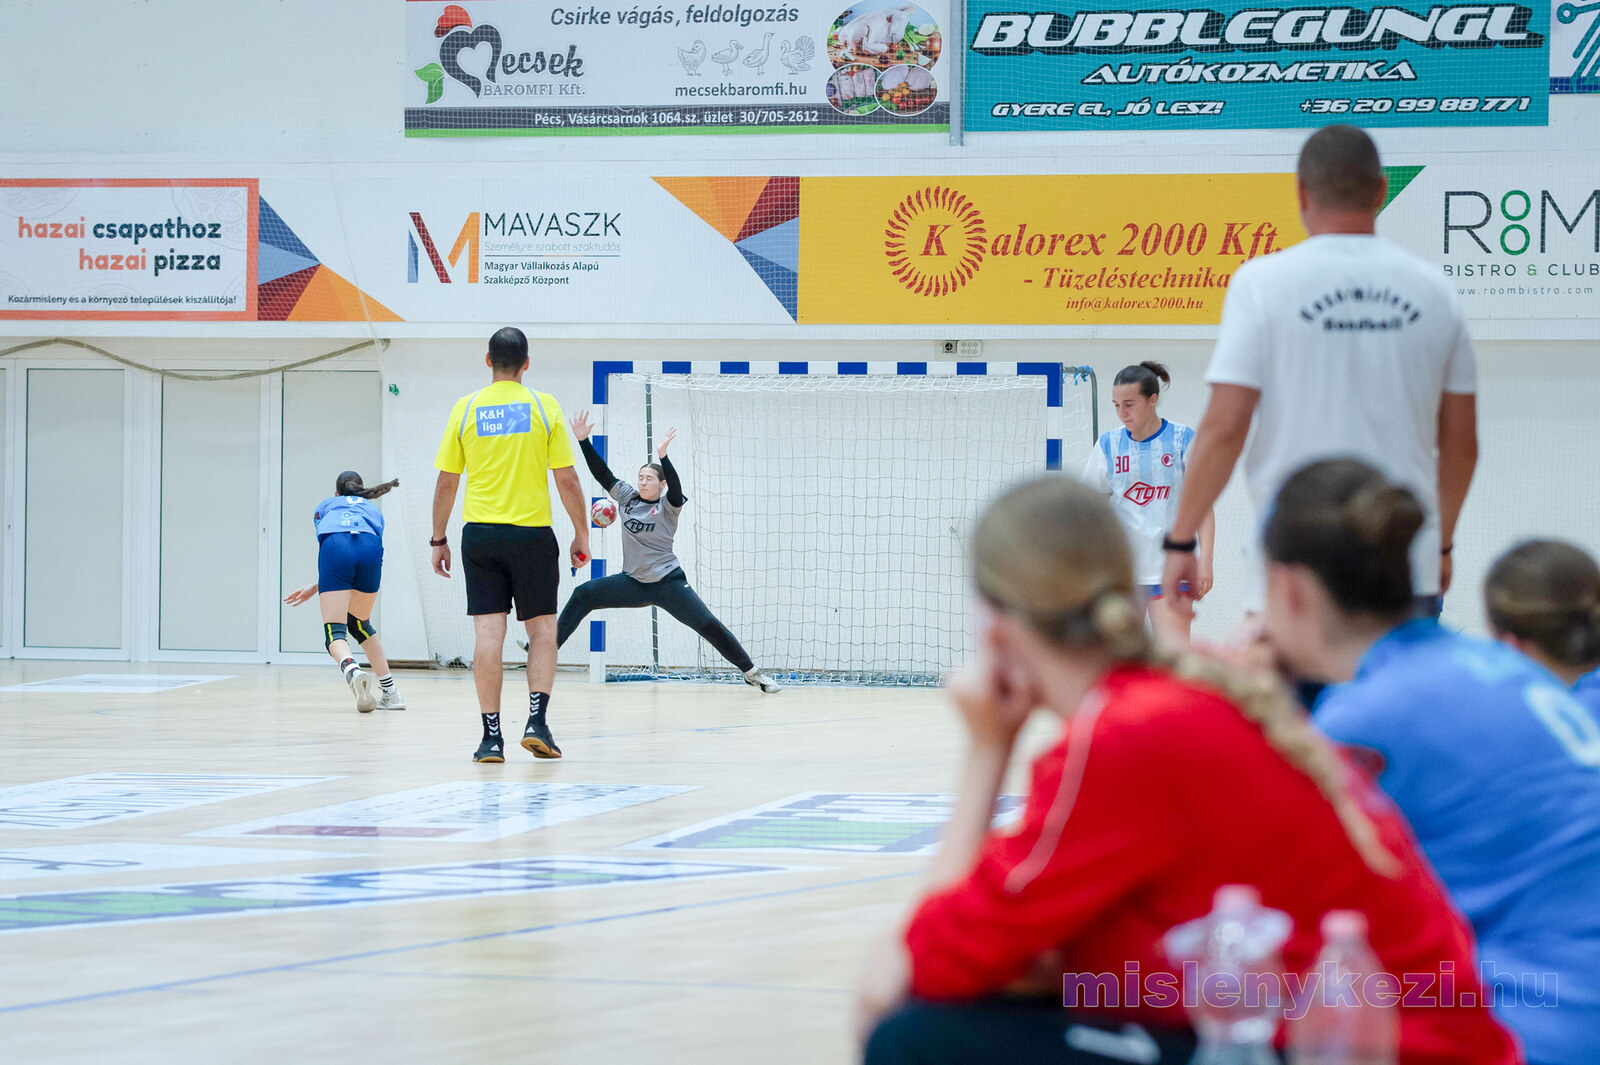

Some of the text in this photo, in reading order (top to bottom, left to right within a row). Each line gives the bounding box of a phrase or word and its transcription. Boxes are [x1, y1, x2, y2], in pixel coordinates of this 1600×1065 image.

[550, 3, 799, 28] Csirke vágás, feldolgozás
[970, 4, 1543, 54] BUBBLEGUNGL
[1082, 57, 1417, 85] AUTÓKOZMETIKA
[483, 83, 586, 96] BAROMFI Kft.
[675, 82, 807, 97] mecsekbaromfi.hu
[991, 97, 1226, 117] GYERE EL, JÓ LESZ!
[1300, 97, 1530, 113] +36 20 99 88 771
[534, 110, 819, 127] Pécs, Vásárcsarnok 1064.sz. üzlet 30/705-2612
[18, 216, 222, 245] hazai csapathoz
[484, 212, 621, 237] MAVASZK
[484, 241, 621, 253] Személyre szabott szaktudás
[1117, 222, 1208, 257] 2000
[1217, 222, 1283, 264] Kft.
[79, 248, 221, 277] hazai pizza
[484, 261, 599, 273] Magyar Vállalkozás Alapú
[1444, 263, 1600, 276] BISTRO & CLUB
[484, 275, 569, 286] Szakképző Központ
[1043, 266, 1231, 290] Tüzeléstechnika
[1457, 286, 1594, 295] ww.roombistro.com
[8, 294, 67, 306] Kozármisleny
[69, 295, 79, 304] és
[130, 294, 183, 306] települések
[1066, 297, 1203, 312] info@kalorex2000.hu
[479, 409, 504, 420] K&H
[482, 422, 503, 433] liga
[1135, 486, 1171, 500] TOTI
[630, 521, 656, 532] TOTI
